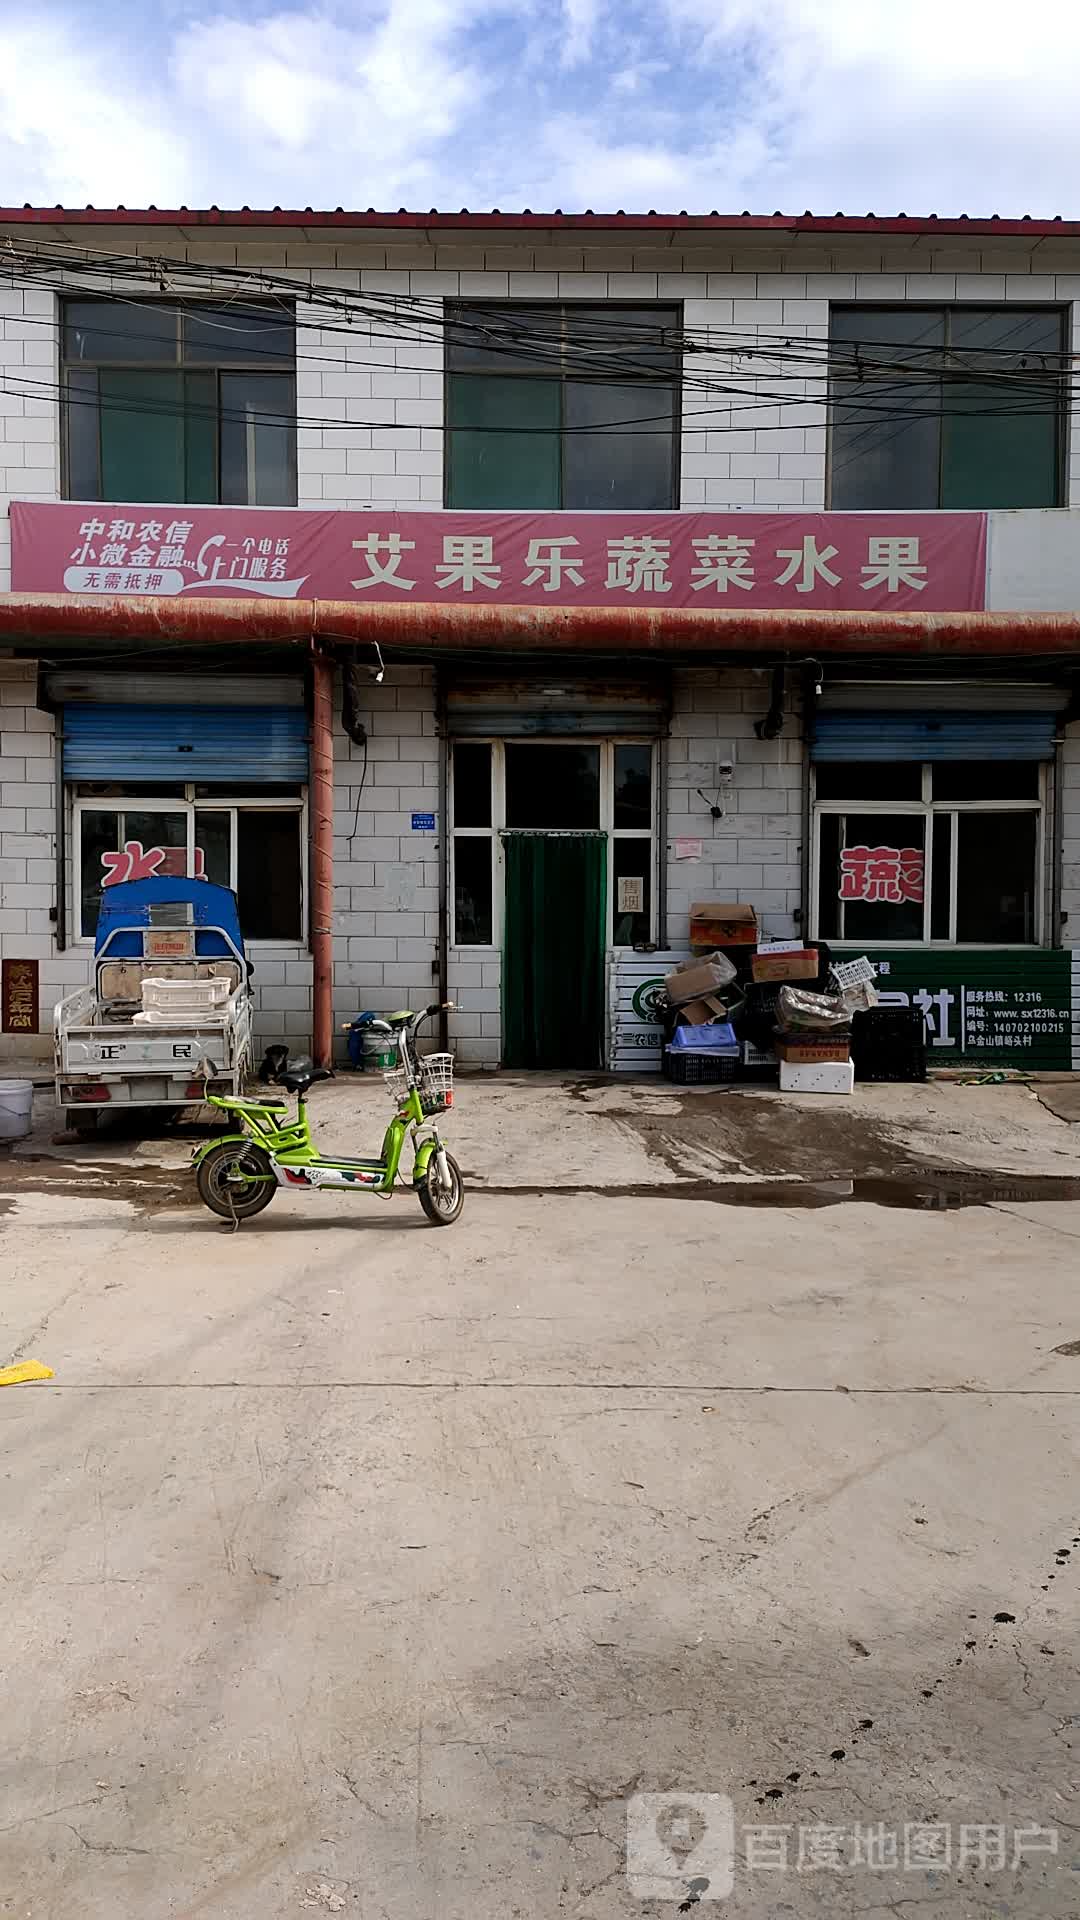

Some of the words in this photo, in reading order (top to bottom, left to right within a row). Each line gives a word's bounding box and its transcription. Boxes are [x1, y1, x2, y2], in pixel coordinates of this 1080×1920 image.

[79, 518, 193, 544] 中和农信
[70, 542, 186, 568] 小微金融
[226, 537, 290, 556] 一个电话
[207, 556, 288, 581] 上门服务
[351, 533, 928, 592] 艾果乐蔬菜水果
[83, 572, 163, 590] 无需抵押
